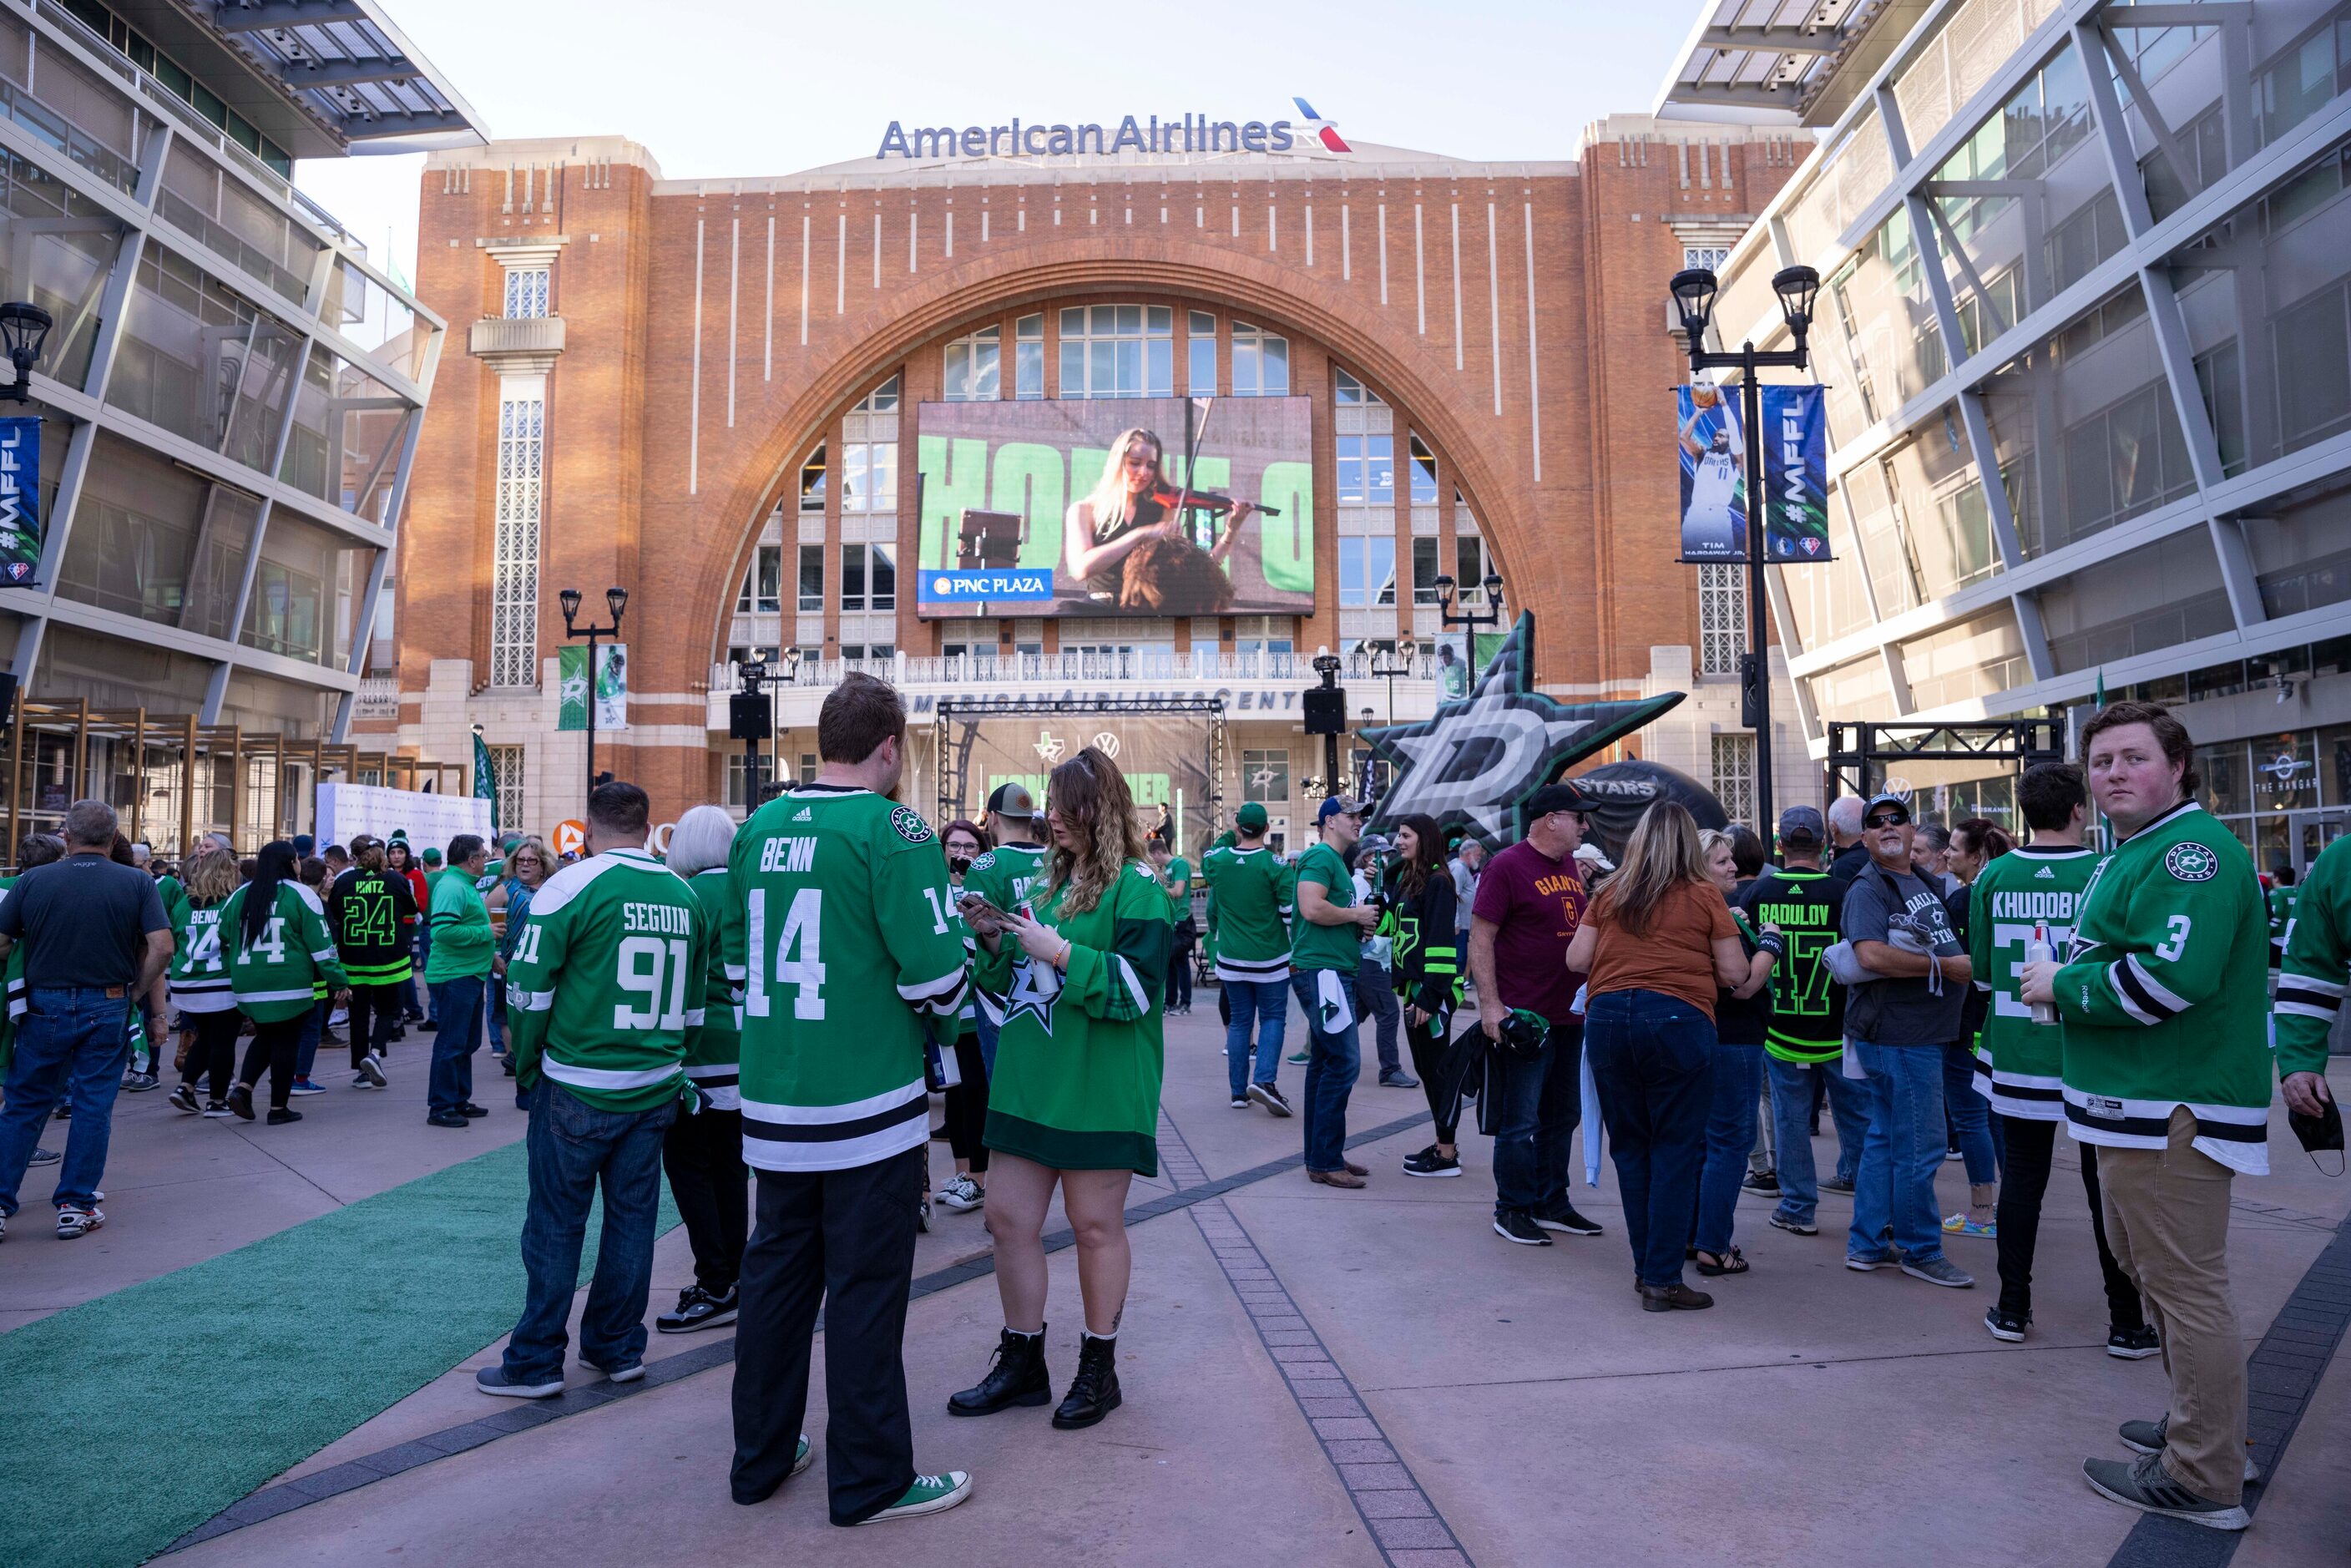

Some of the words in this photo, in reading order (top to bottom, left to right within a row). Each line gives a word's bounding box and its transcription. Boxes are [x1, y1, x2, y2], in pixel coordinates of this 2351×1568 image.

[877, 117, 1103, 159] American
[1110, 112, 1293, 154] Airlines
[1782, 393, 1807, 524] #MFFL
[953, 577, 989, 594] PNC
[993, 576, 1044, 593] PLAZA
[1212, 687, 1305, 712] CENT
[1573, 777, 1657, 797] STARS
[2255, 782, 2273, 794] THE
[759, 836, 818, 873] BENN
[2171, 844, 2215, 863] DALLAS
[355, 880, 385, 894] HINTZ
[1534, 875, 1585, 897] GIANTS
[2171, 865, 2212, 879] STARS
[190, 909, 220, 925] BENN
[344, 895, 396, 946] 24
[623, 902, 690, 936] SEGUIN
[1758, 903, 1830, 926] RADULOV
[180, 924, 223, 974] 14
[511, 923, 543, 964] 91
[2155, 914, 2192, 963] 3
[745, 888, 827, 1020] 14
[613, 936, 688, 1031] 91
[2081, 984, 2091, 1014] Reebok
